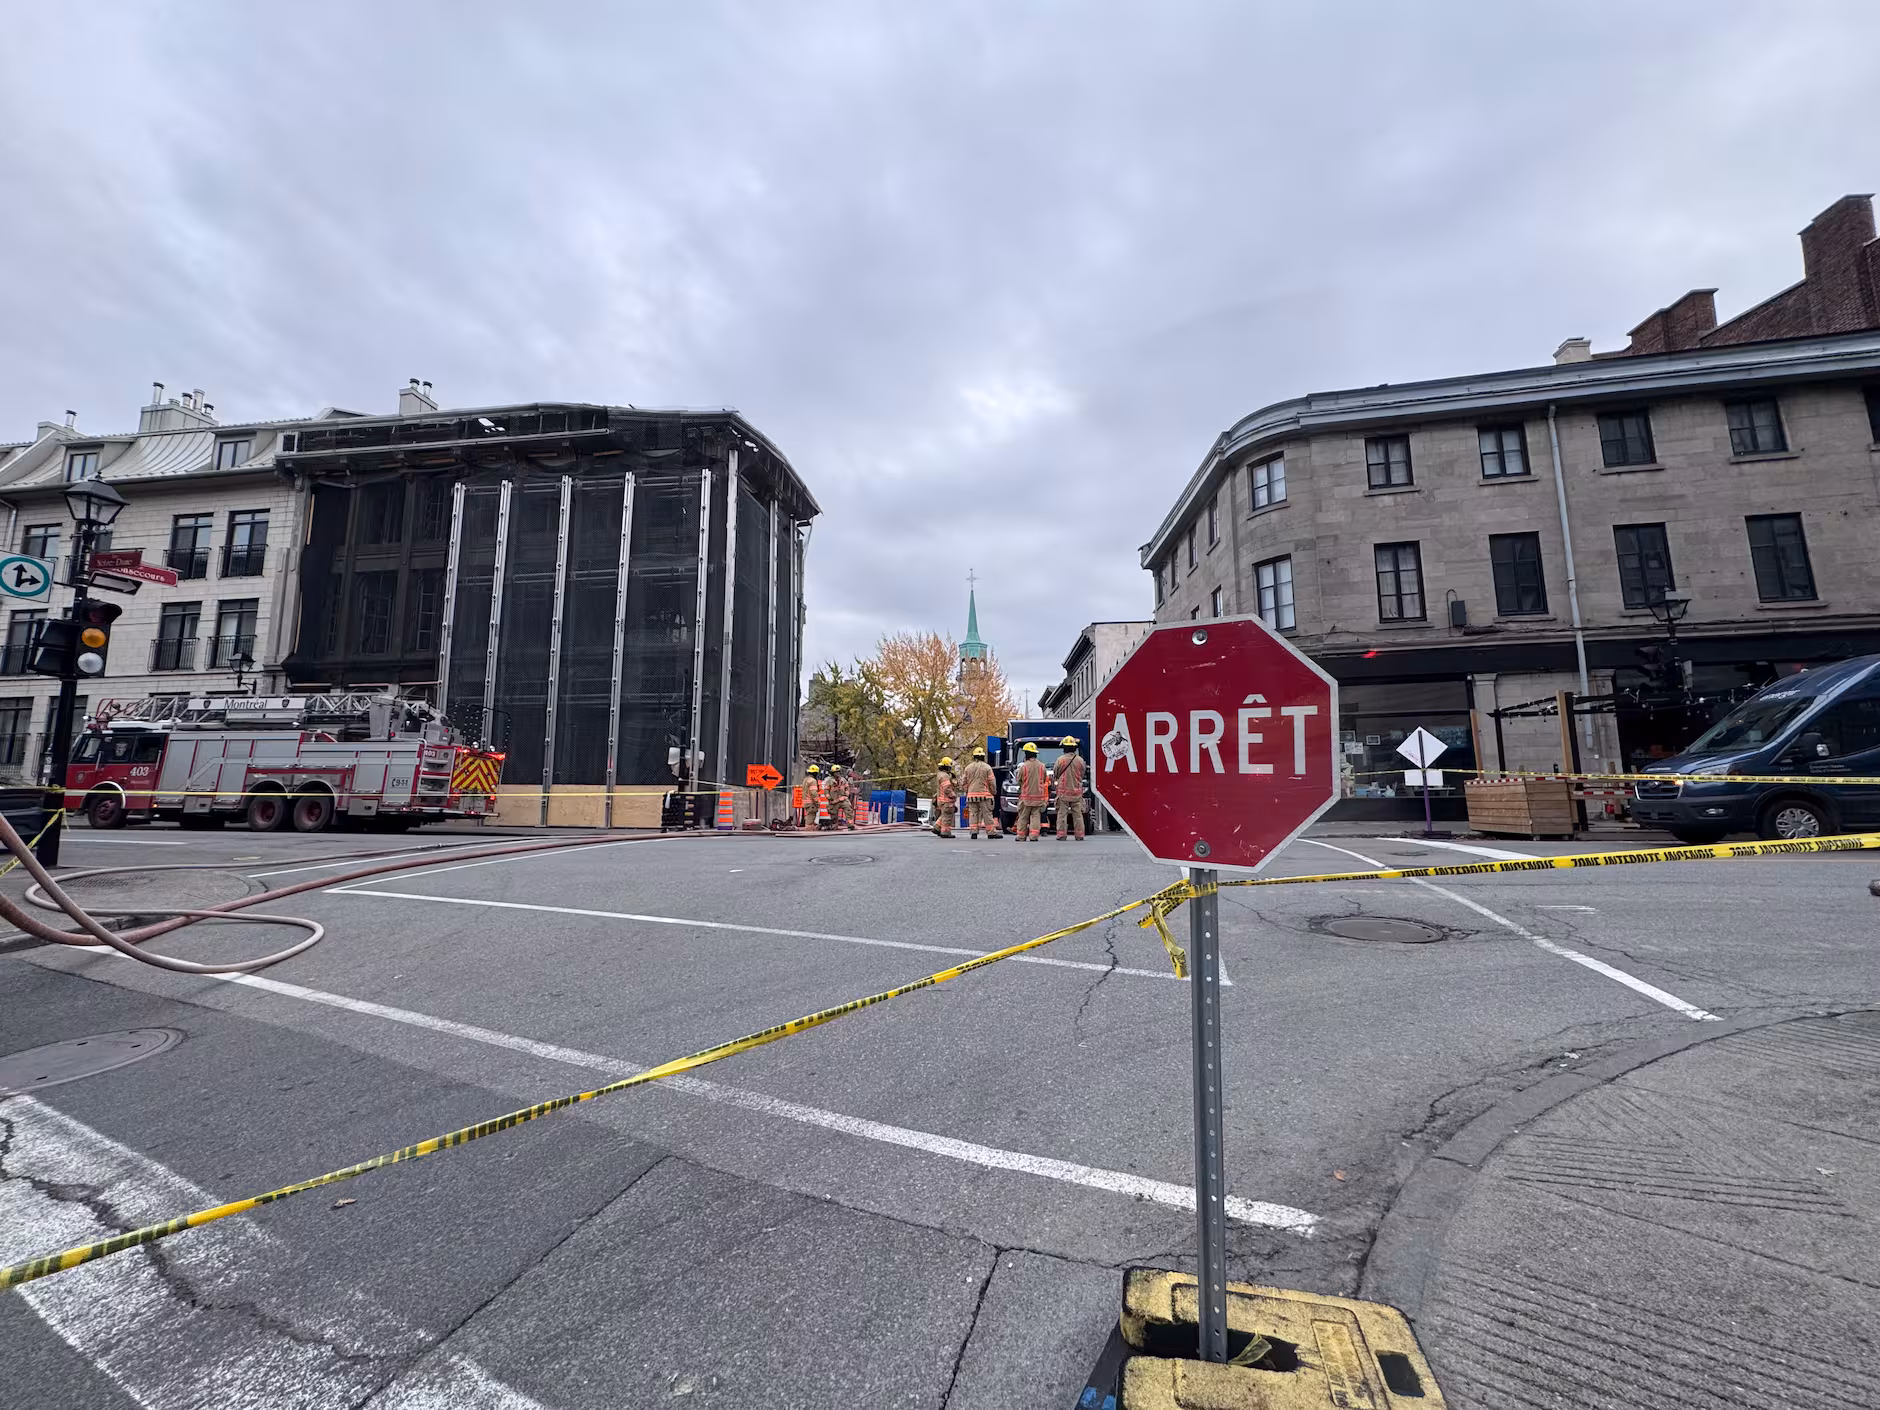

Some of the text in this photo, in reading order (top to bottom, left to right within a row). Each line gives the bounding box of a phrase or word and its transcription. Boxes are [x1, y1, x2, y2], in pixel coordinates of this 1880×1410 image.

[224, 698, 268, 709] Montréal
[1104, 693, 1318, 776] ARRÊT
[129, 766, 149, 776] 403
